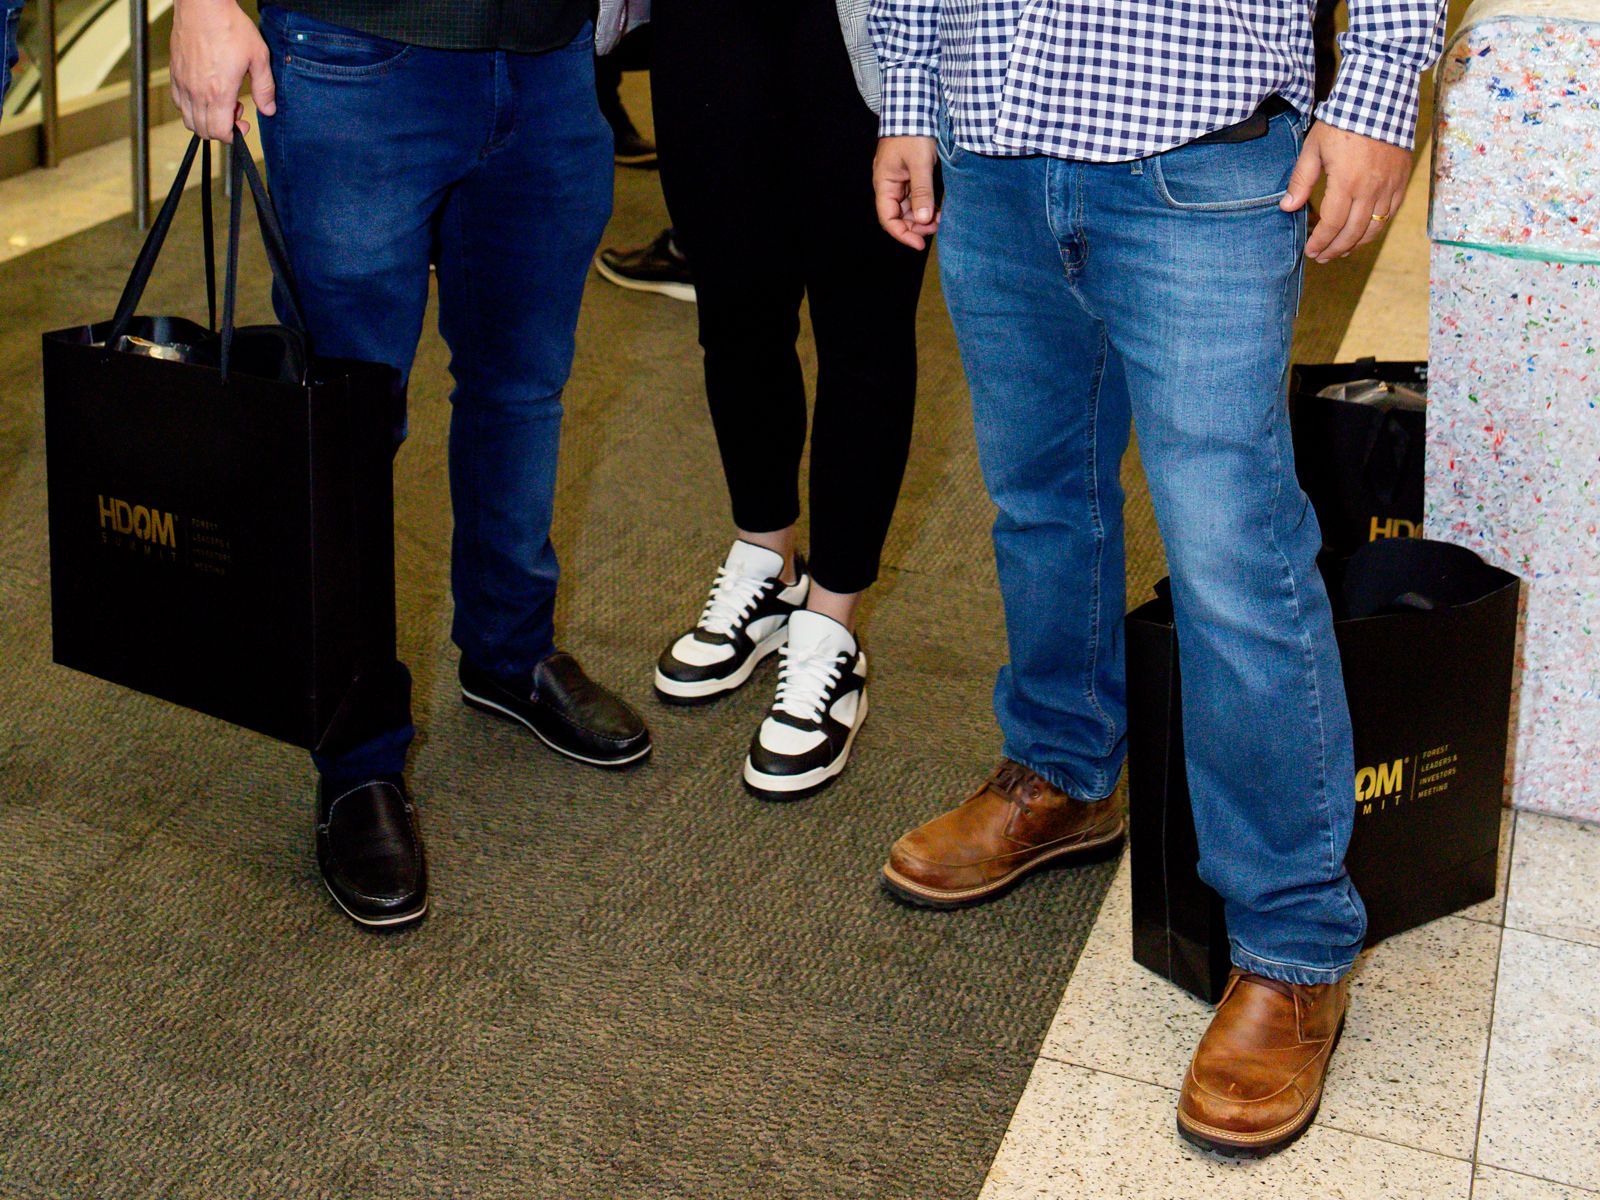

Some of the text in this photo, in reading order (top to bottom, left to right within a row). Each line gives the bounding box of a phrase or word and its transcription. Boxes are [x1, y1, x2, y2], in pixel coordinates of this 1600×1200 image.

[98, 494, 176, 548] HDOM
[1369, 516, 1424, 542] HD
[1423, 744, 1448, 759] FOREST
[1421, 757, 1451, 772] LEADERS
[1355, 759, 1403, 802] OM
[1420, 767, 1456, 785] INVESTORS
[1418, 783, 1448, 799] MEETING
[1363, 795, 1400, 815] MIT
